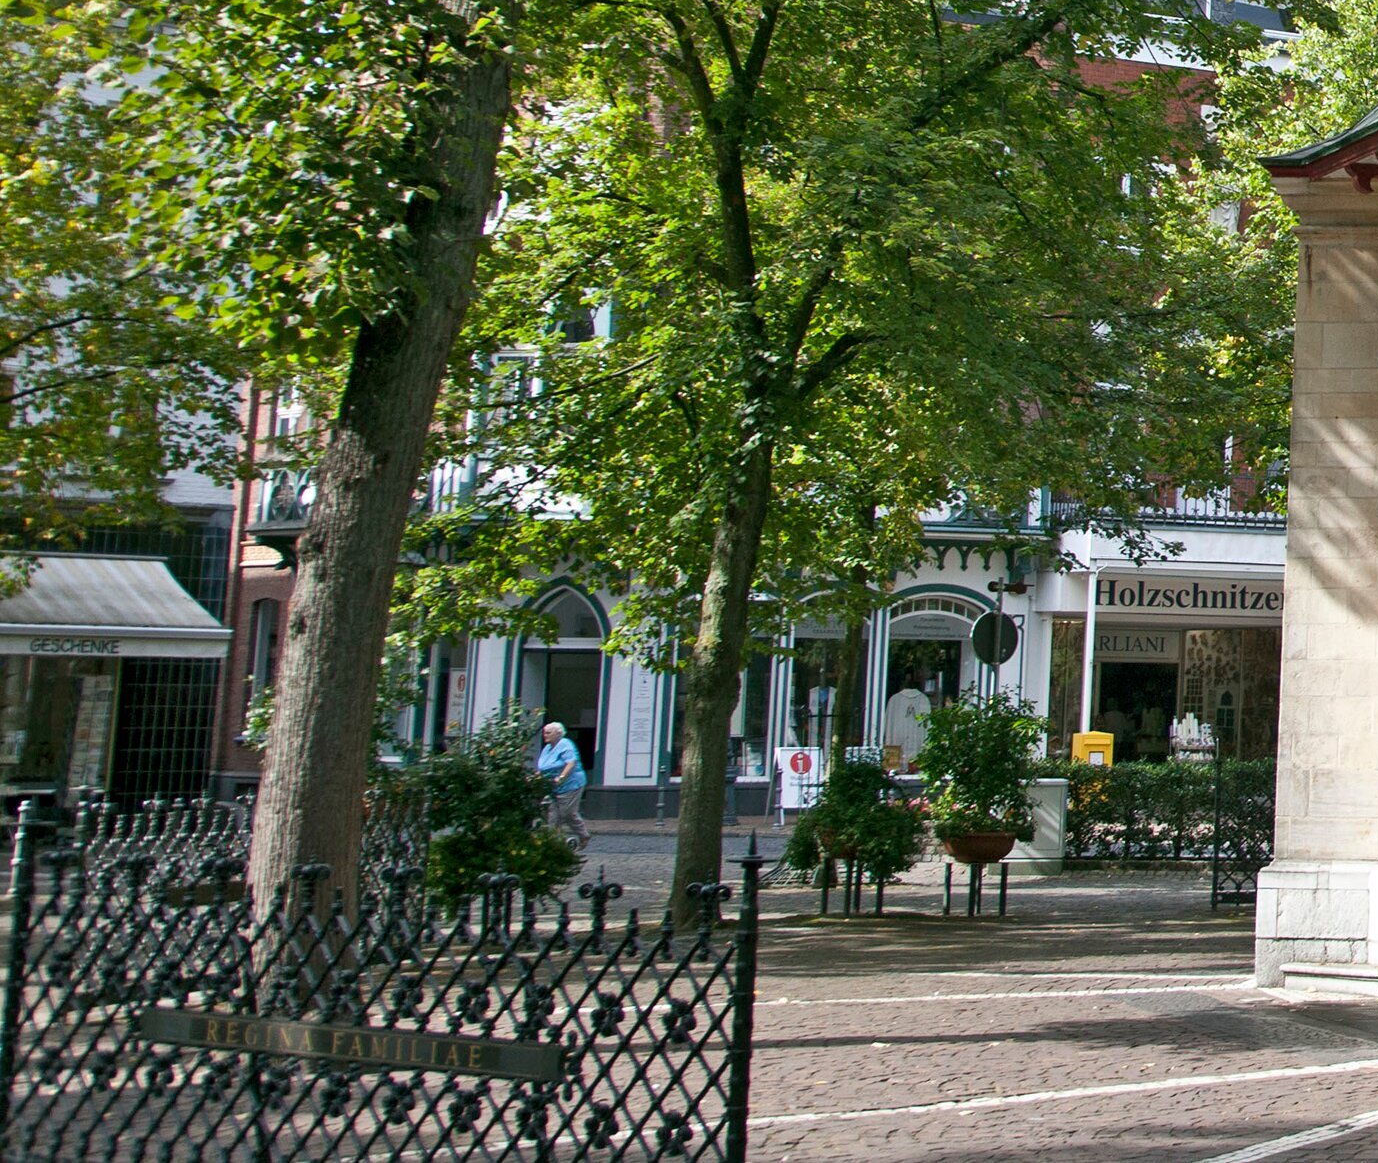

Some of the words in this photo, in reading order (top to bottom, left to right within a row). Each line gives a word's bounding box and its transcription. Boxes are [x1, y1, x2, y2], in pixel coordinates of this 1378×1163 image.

[30, 639, 120, 654] GESCHENKE
[1095, 635, 1166, 653] RLIANI
[206, 1019, 313, 1051] REGINA
[331, 1031, 482, 1068] FAMILIAE
